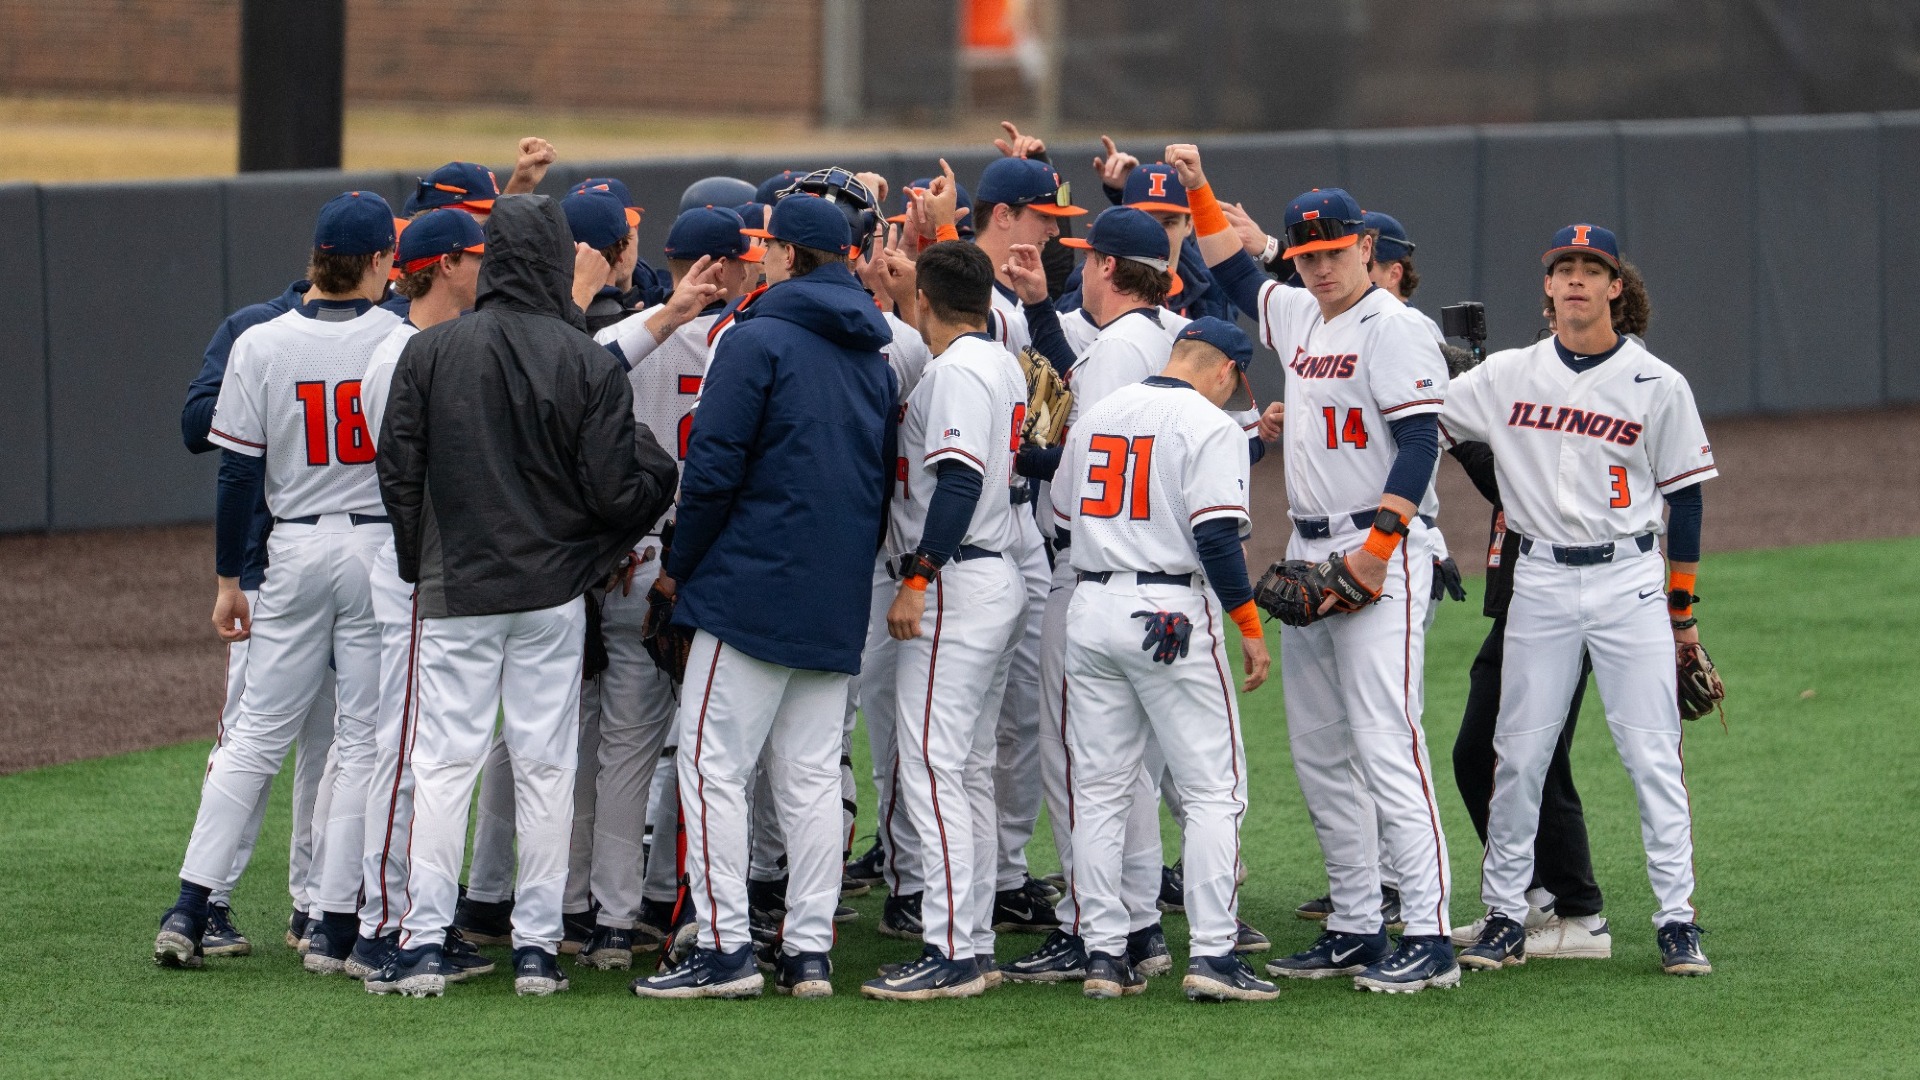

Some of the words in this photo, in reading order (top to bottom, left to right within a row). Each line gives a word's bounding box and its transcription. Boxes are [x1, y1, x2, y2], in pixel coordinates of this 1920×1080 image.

[1148, 172, 1167, 197] I
[1571, 225, 1592, 245] I
[296, 379, 377, 466] 18
[1322, 406, 1368, 450] 14
[1508, 402, 1643, 446] ILLINOIS
[1080, 433, 1156, 521] 31
[1609, 465, 1632, 509] 3
[1337, 574, 1364, 602] Wilson
